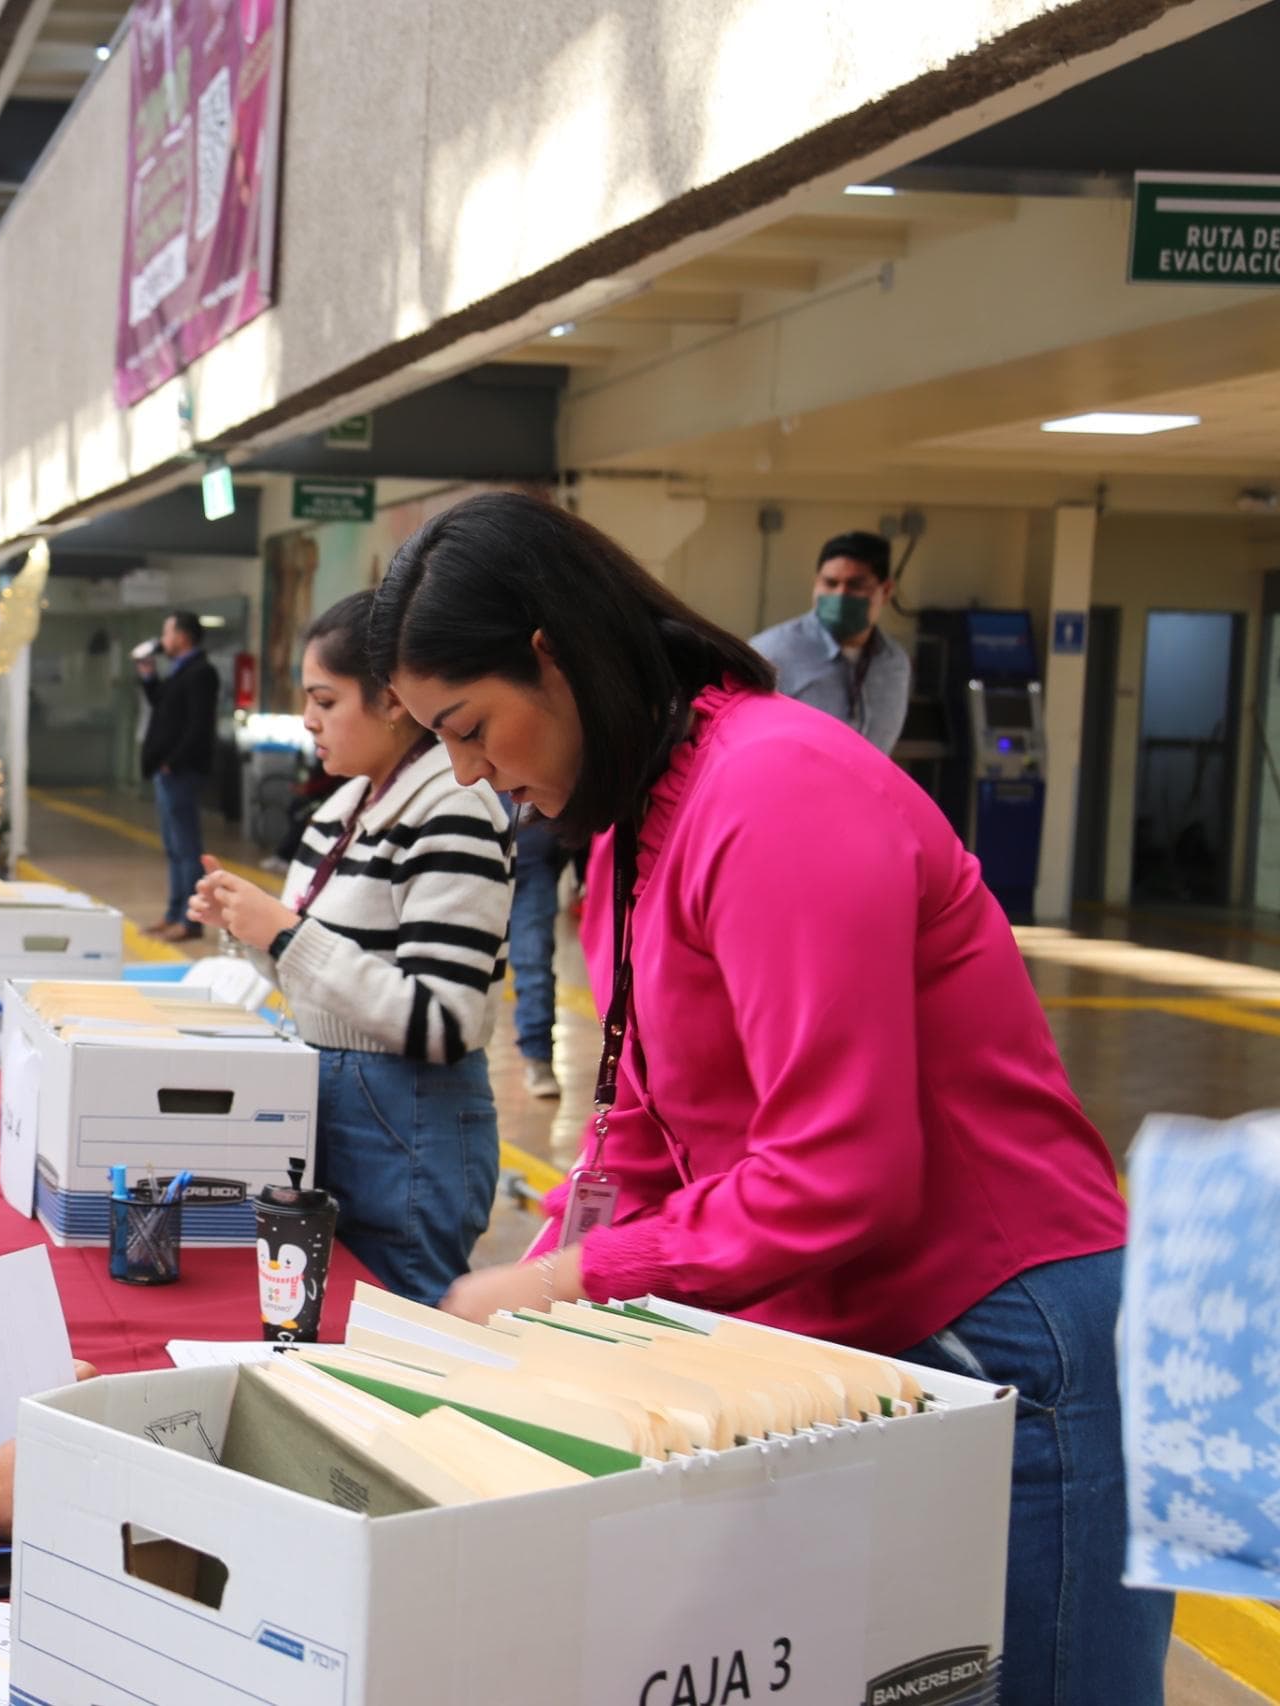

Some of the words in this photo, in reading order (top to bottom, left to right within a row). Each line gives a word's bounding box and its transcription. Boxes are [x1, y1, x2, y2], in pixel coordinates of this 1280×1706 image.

[1186, 225, 1246, 249] RUTA
[1253, 227, 1280, 250] DE
[639, 1649, 751, 1706] CAJA
[769, 1636, 792, 1692] 3
[873, 1669, 950, 1706] BANKERS
[951, 1658, 983, 1682] BOX
